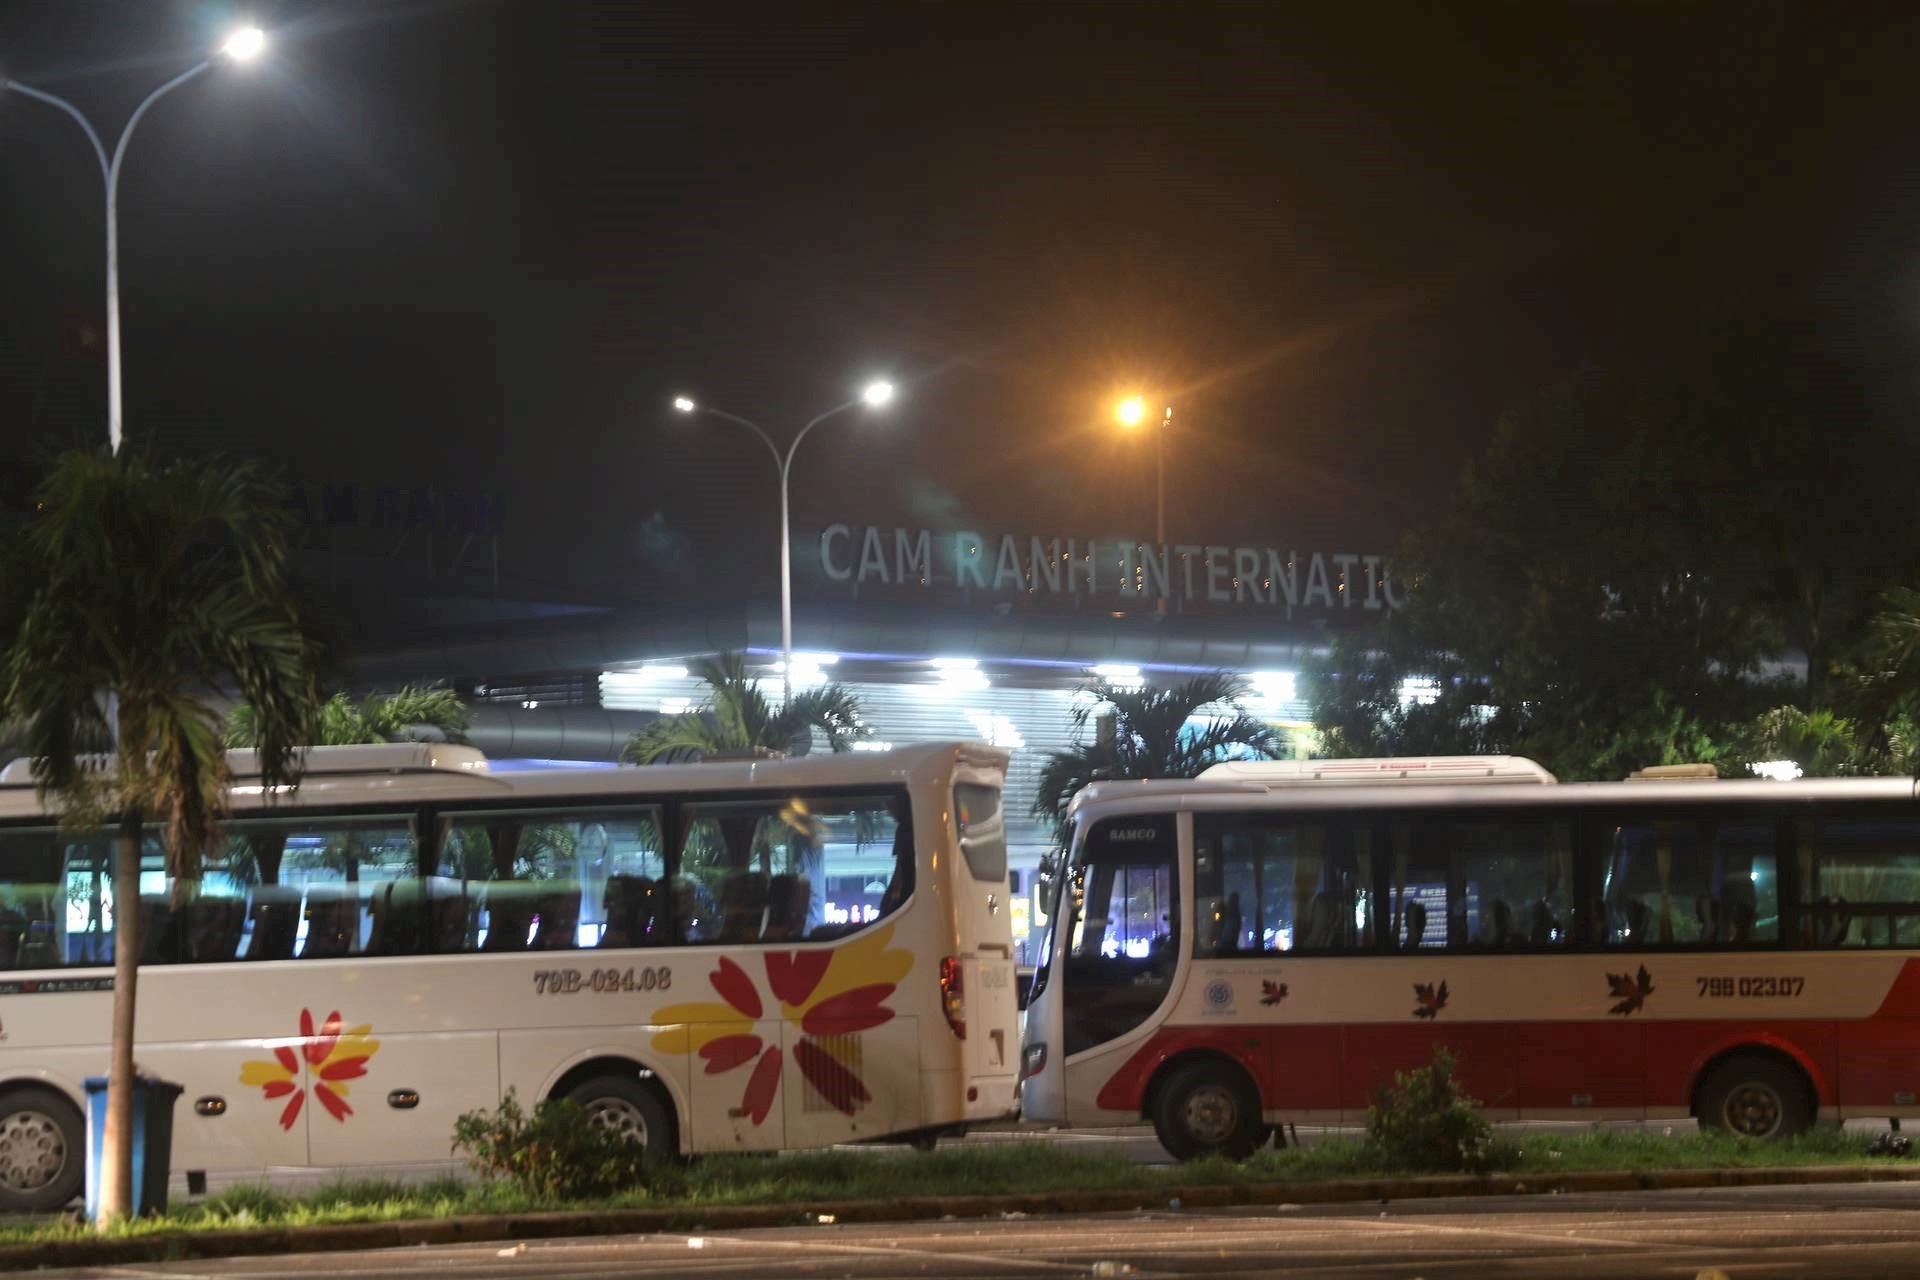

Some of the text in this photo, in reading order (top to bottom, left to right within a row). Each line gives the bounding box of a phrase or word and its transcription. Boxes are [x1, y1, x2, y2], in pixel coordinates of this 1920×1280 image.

[820, 523, 932, 586] CAM
[956, 531, 1097, 595] RANH
[533, 966, 673, 995] 79B-024.08
[1696, 976, 1734, 997] 79B
